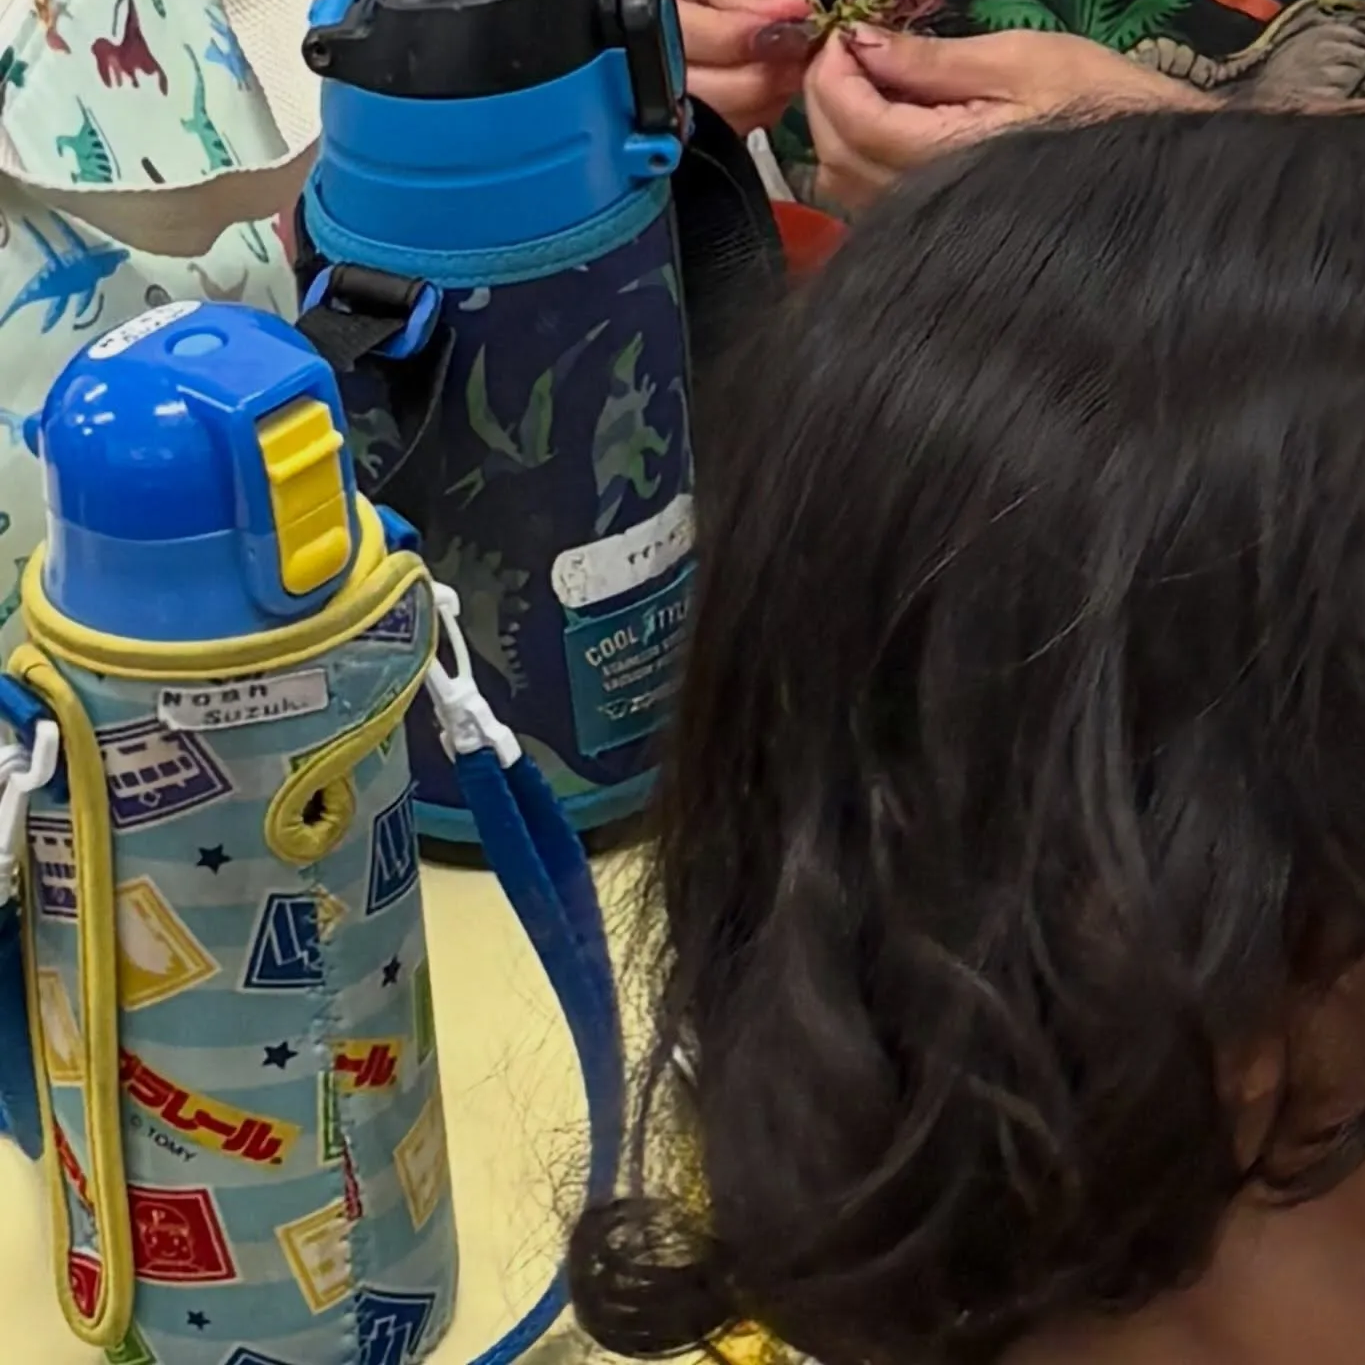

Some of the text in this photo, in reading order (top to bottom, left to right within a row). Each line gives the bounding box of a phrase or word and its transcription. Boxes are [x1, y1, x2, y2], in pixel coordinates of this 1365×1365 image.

[584, 626, 639, 668] COOL
[162, 683, 269, 707] Noah
[147, 1125, 198, 1163] TOMY
